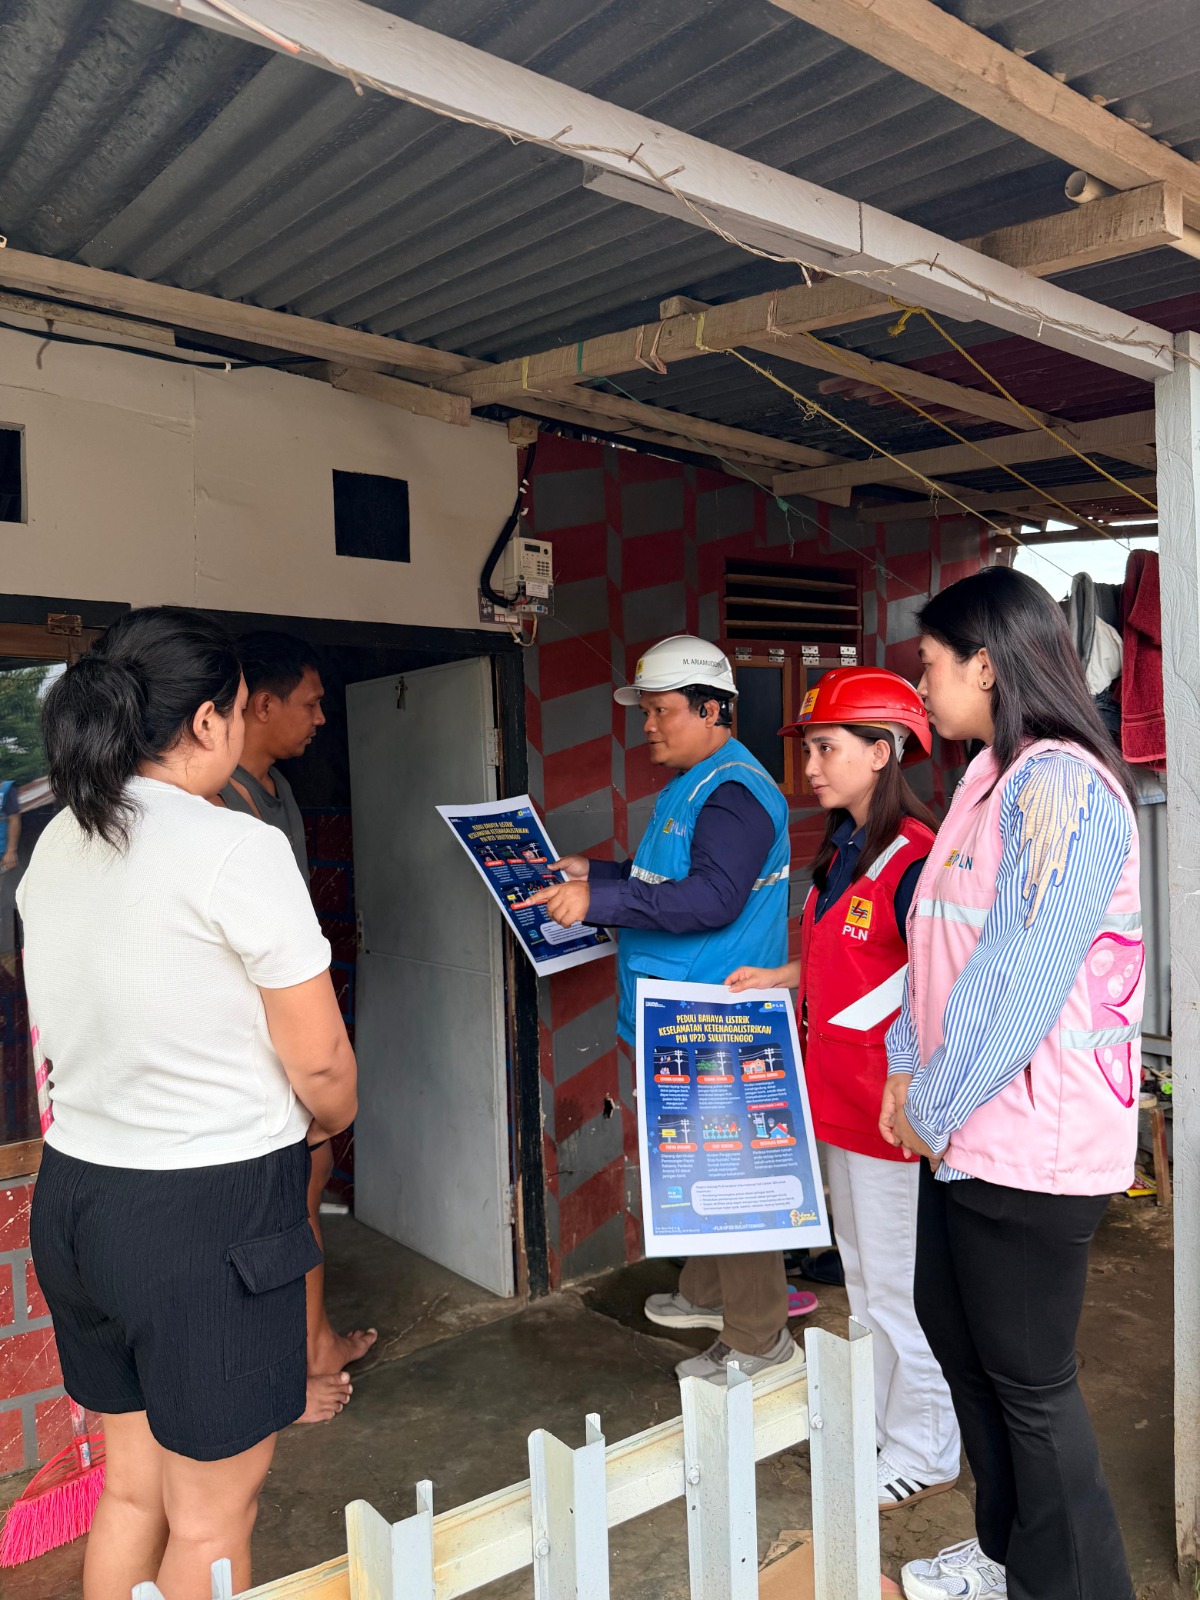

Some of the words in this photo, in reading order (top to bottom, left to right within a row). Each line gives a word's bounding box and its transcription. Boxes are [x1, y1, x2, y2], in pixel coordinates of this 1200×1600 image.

[952, 853, 973, 870] PLN
[842, 924, 869, 941] PLN
[698, 1014, 724, 1023] BAHAYA
[658, 1024, 703, 1037] KESELAMATAN
[675, 1034, 689, 1043] PLN
[689, 1034, 706, 1043] UP2D
[707, 1034, 754, 1043] SULUTTENGGO
